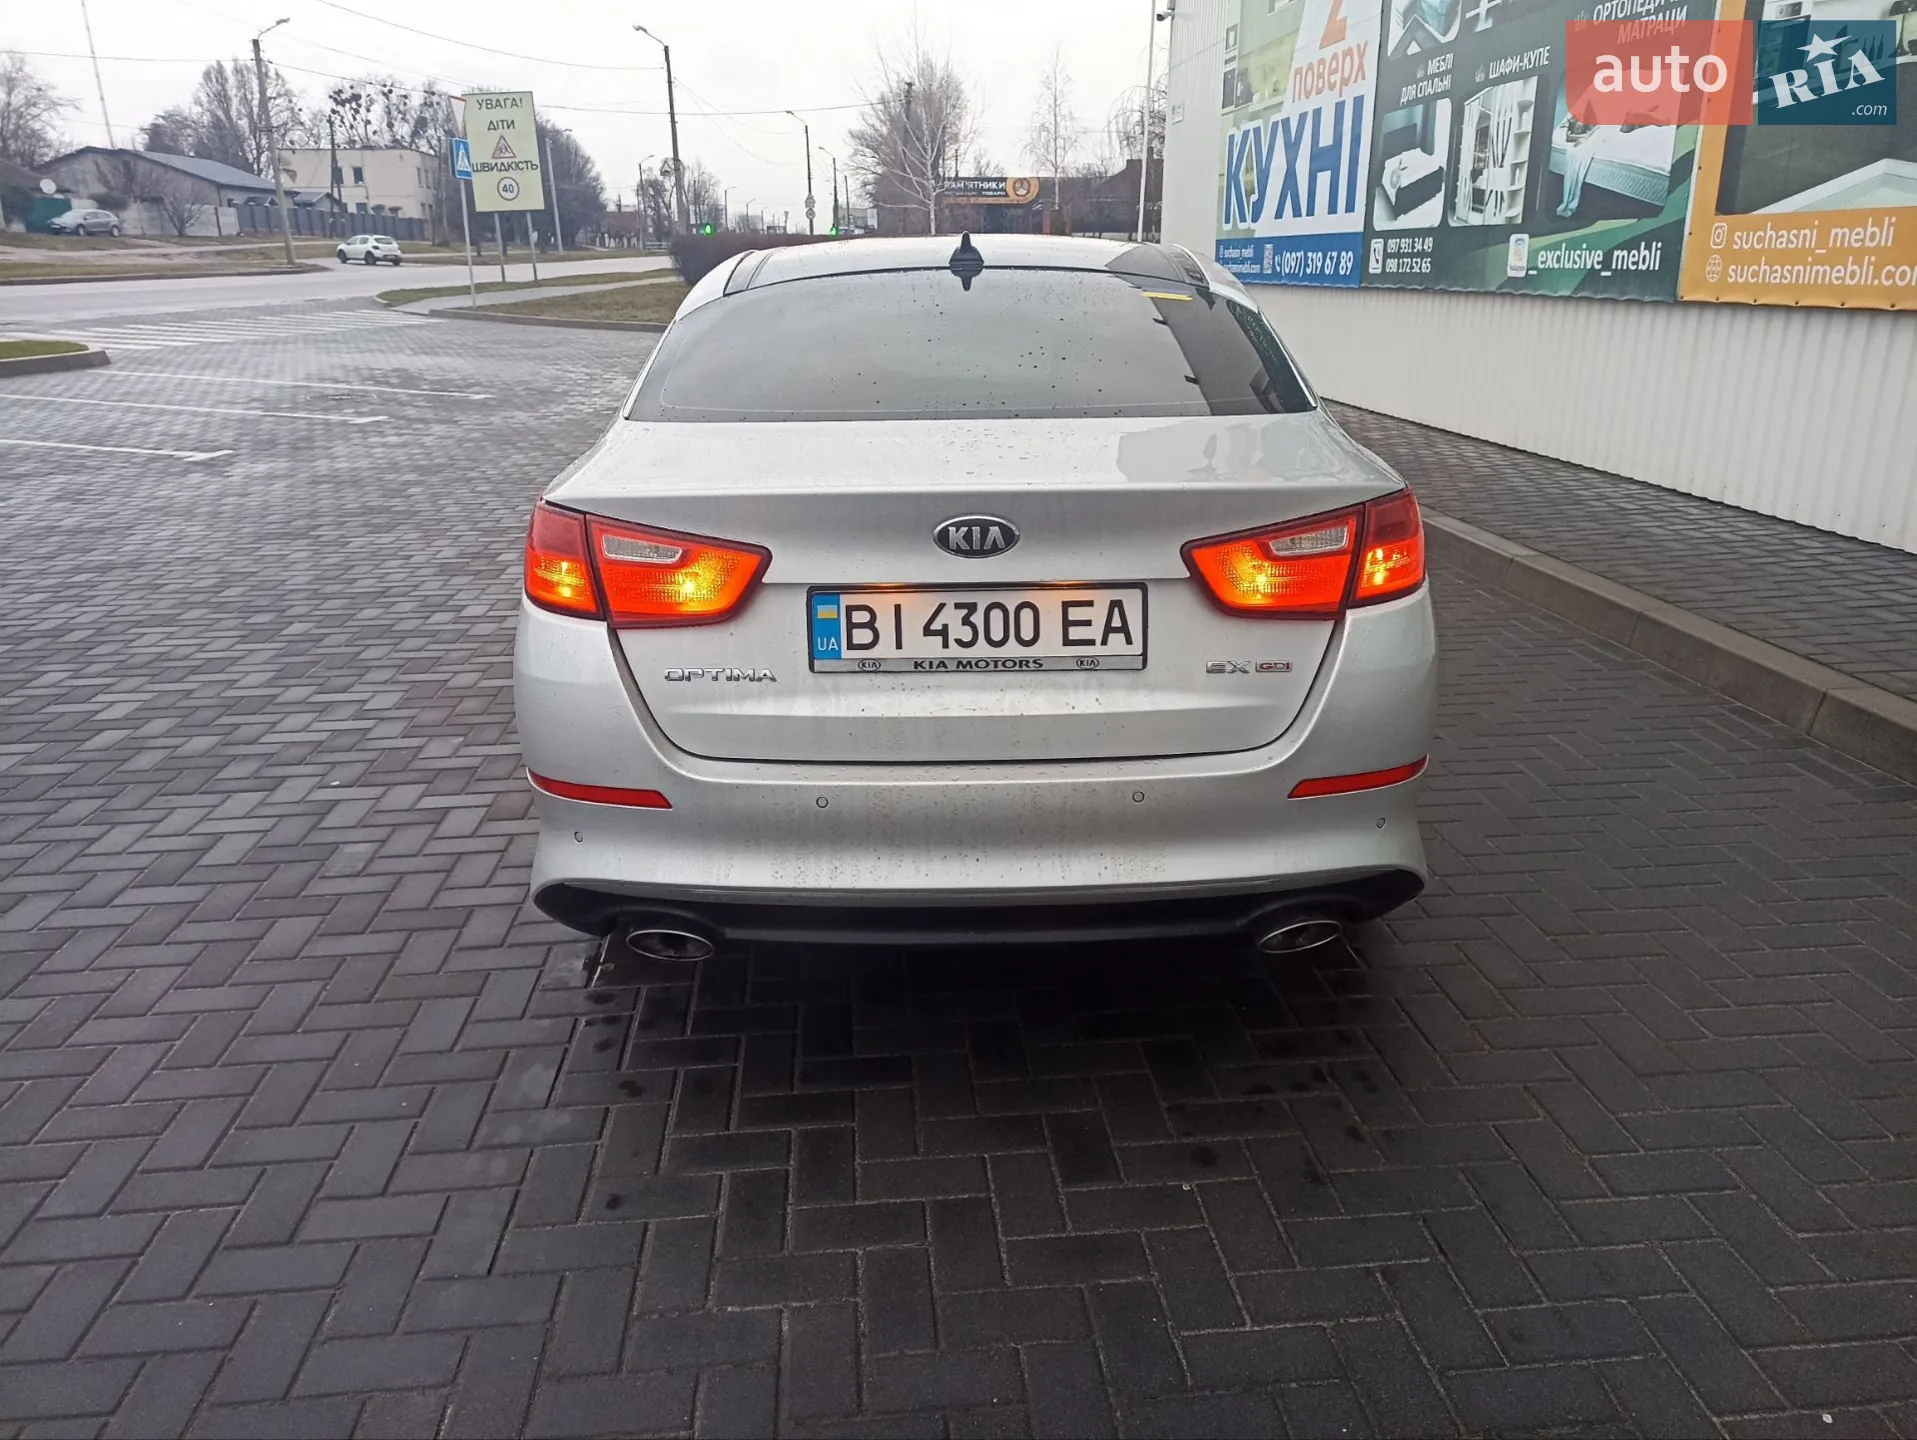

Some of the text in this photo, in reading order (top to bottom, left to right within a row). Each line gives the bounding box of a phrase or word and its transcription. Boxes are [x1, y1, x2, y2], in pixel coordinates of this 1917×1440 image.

[1617, 5, 1688, 44] МАТРАЦИ
[1427, 52, 1454, 76] МЕБЛІ
[1488, 45, 1551, 79] ШАФИ-КУПЕ
[1291, 41, 1369, 103] поверх
[1400, 73, 1452, 106] ДЛЯ СПАЛЬНІ
[476, 98, 523, 110] УВАГА!
[487, 119, 515, 131] ДІТИ
[471, 160, 539, 173] ШВИДКІСТЬ
[1223, 95, 1364, 225] КУХНІ
[502, 184, 514, 193] 40
[1732, 216, 1896, 254] suchasni_mebli
[1387, 237, 1433, 253] 097 931 34 49
[1281, 250, 1304, 277] (097)
[1306, 251, 1322, 274] 319
[1324, 251, 1338, 274] 67
[1339, 250, 1354, 275] 89
[1398, 258, 1411, 272] 172
[1412, 258, 1421, 272] 52
[1421, 258, 1431, 273] 65
[947, 526, 1006, 550] KIA
[846, 599, 1133, 650] BI 4300 EA
[817, 637, 839, 651] UA
[861, 661, 878, 669] KIA
[913, 658, 1044, 670] KIA MOTORS
[1078, 658, 1097, 667] KIA
[1206, 660, 1251, 674] EX
[664, 668, 778, 682] OPTIMA
